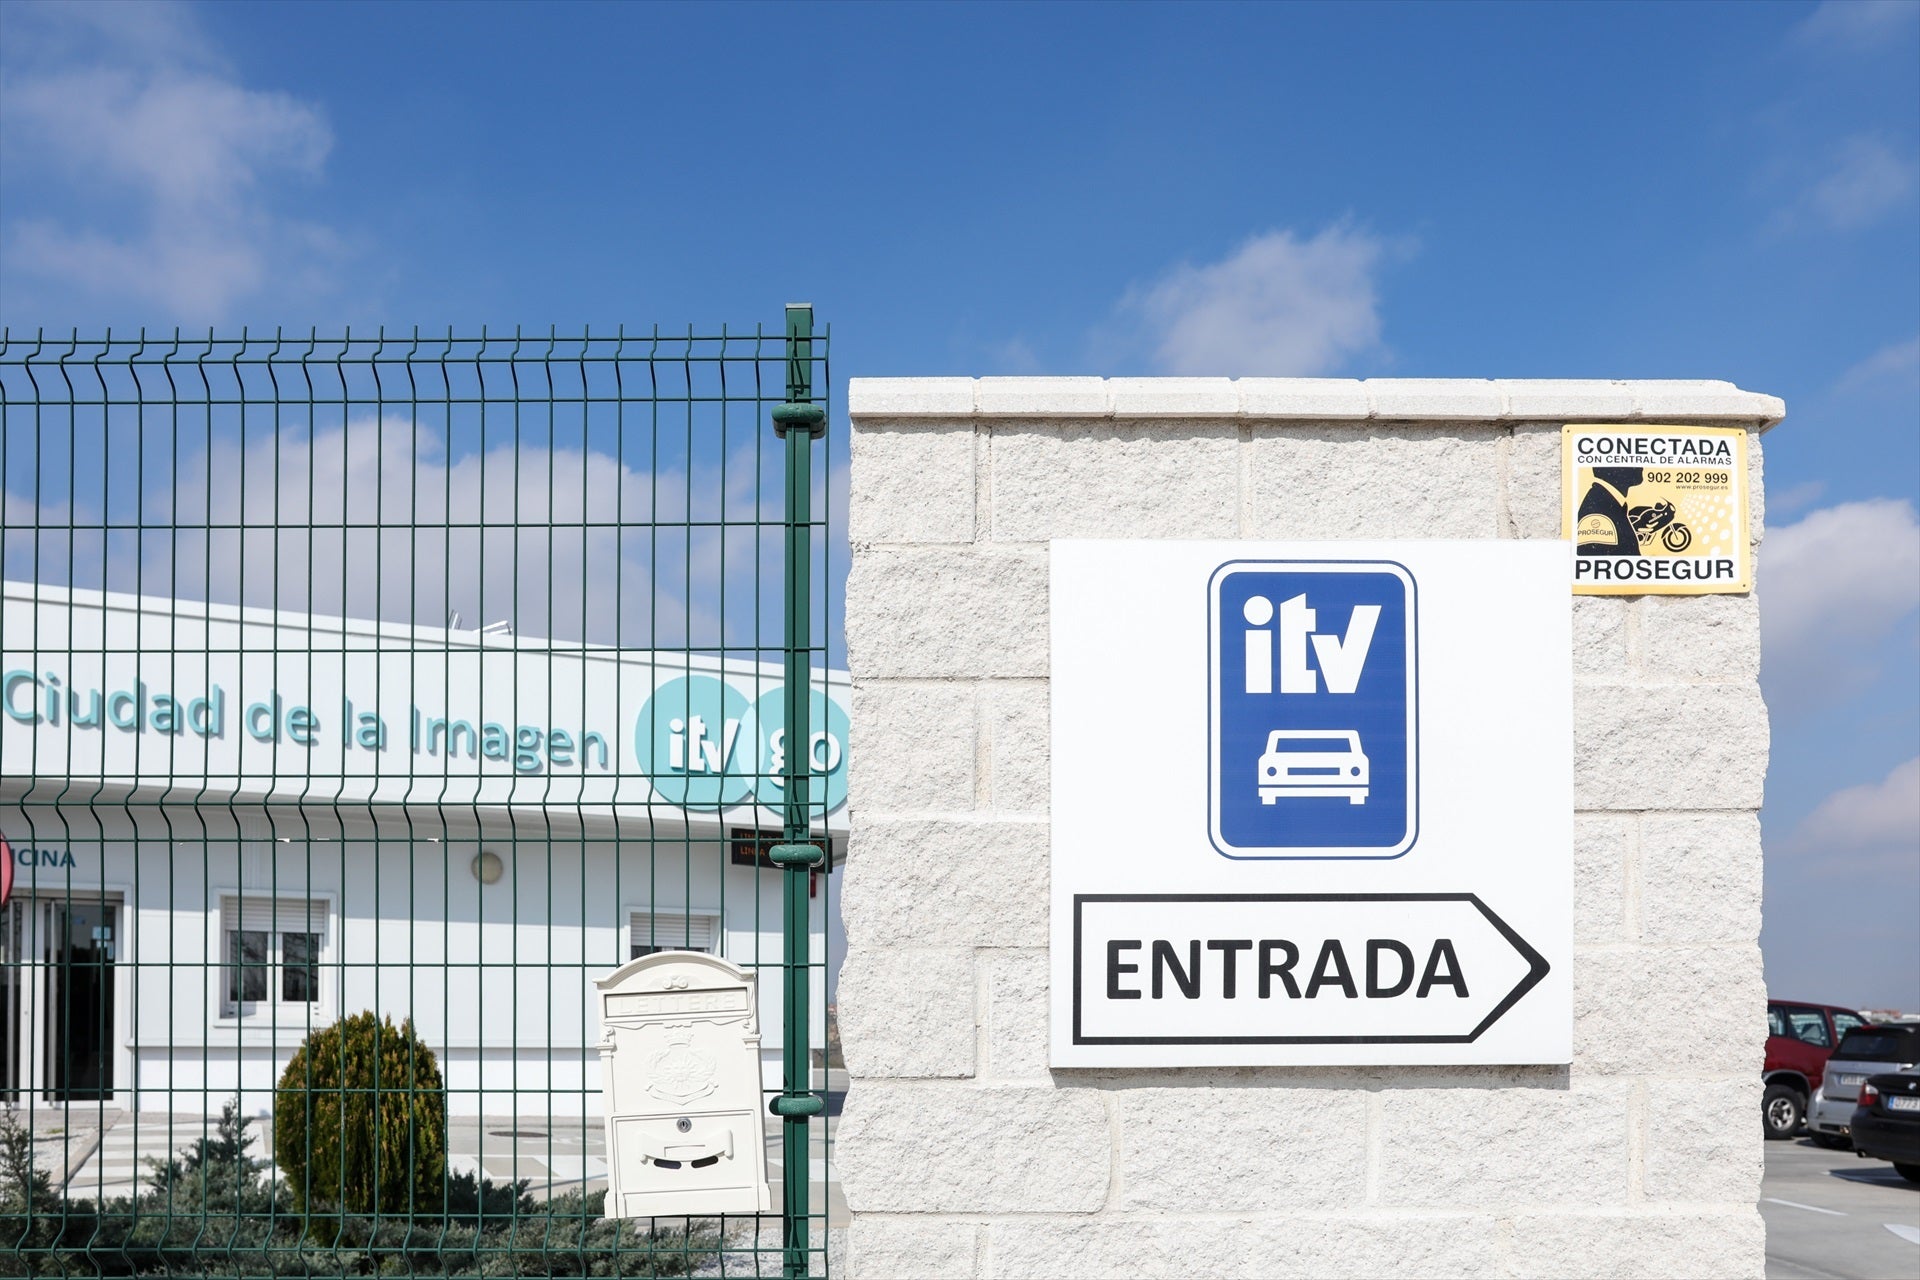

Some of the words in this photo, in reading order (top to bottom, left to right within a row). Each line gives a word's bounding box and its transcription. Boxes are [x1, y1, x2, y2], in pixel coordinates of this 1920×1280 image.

[1577, 437, 1731, 456] CONECTADA
[1577, 455, 1602, 464] CON
[1606, 455, 1656, 464] CENTRAL
[1660, 456, 1674, 464] DE
[1678, 456, 1732, 465] ALARMAS
[1647, 472, 1671, 483] 902
[1676, 472, 1700, 483] 202
[1705, 472, 1728, 484] 999
[1577, 529, 1614, 537] PROSEGUR
[1575, 559, 1734, 579] PROSEGUR
[1243, 592, 1382, 694] itv
[1, 669, 220, 735] Ciudad
[245, 690, 317, 742] de
[343, 696, 385, 748] la
[410, 703, 606, 770] Imagen
[669, 714, 740, 773] itv
[740, 846, 766, 856] LINA
[1106, 938, 1470, 1000] ENTRADA
